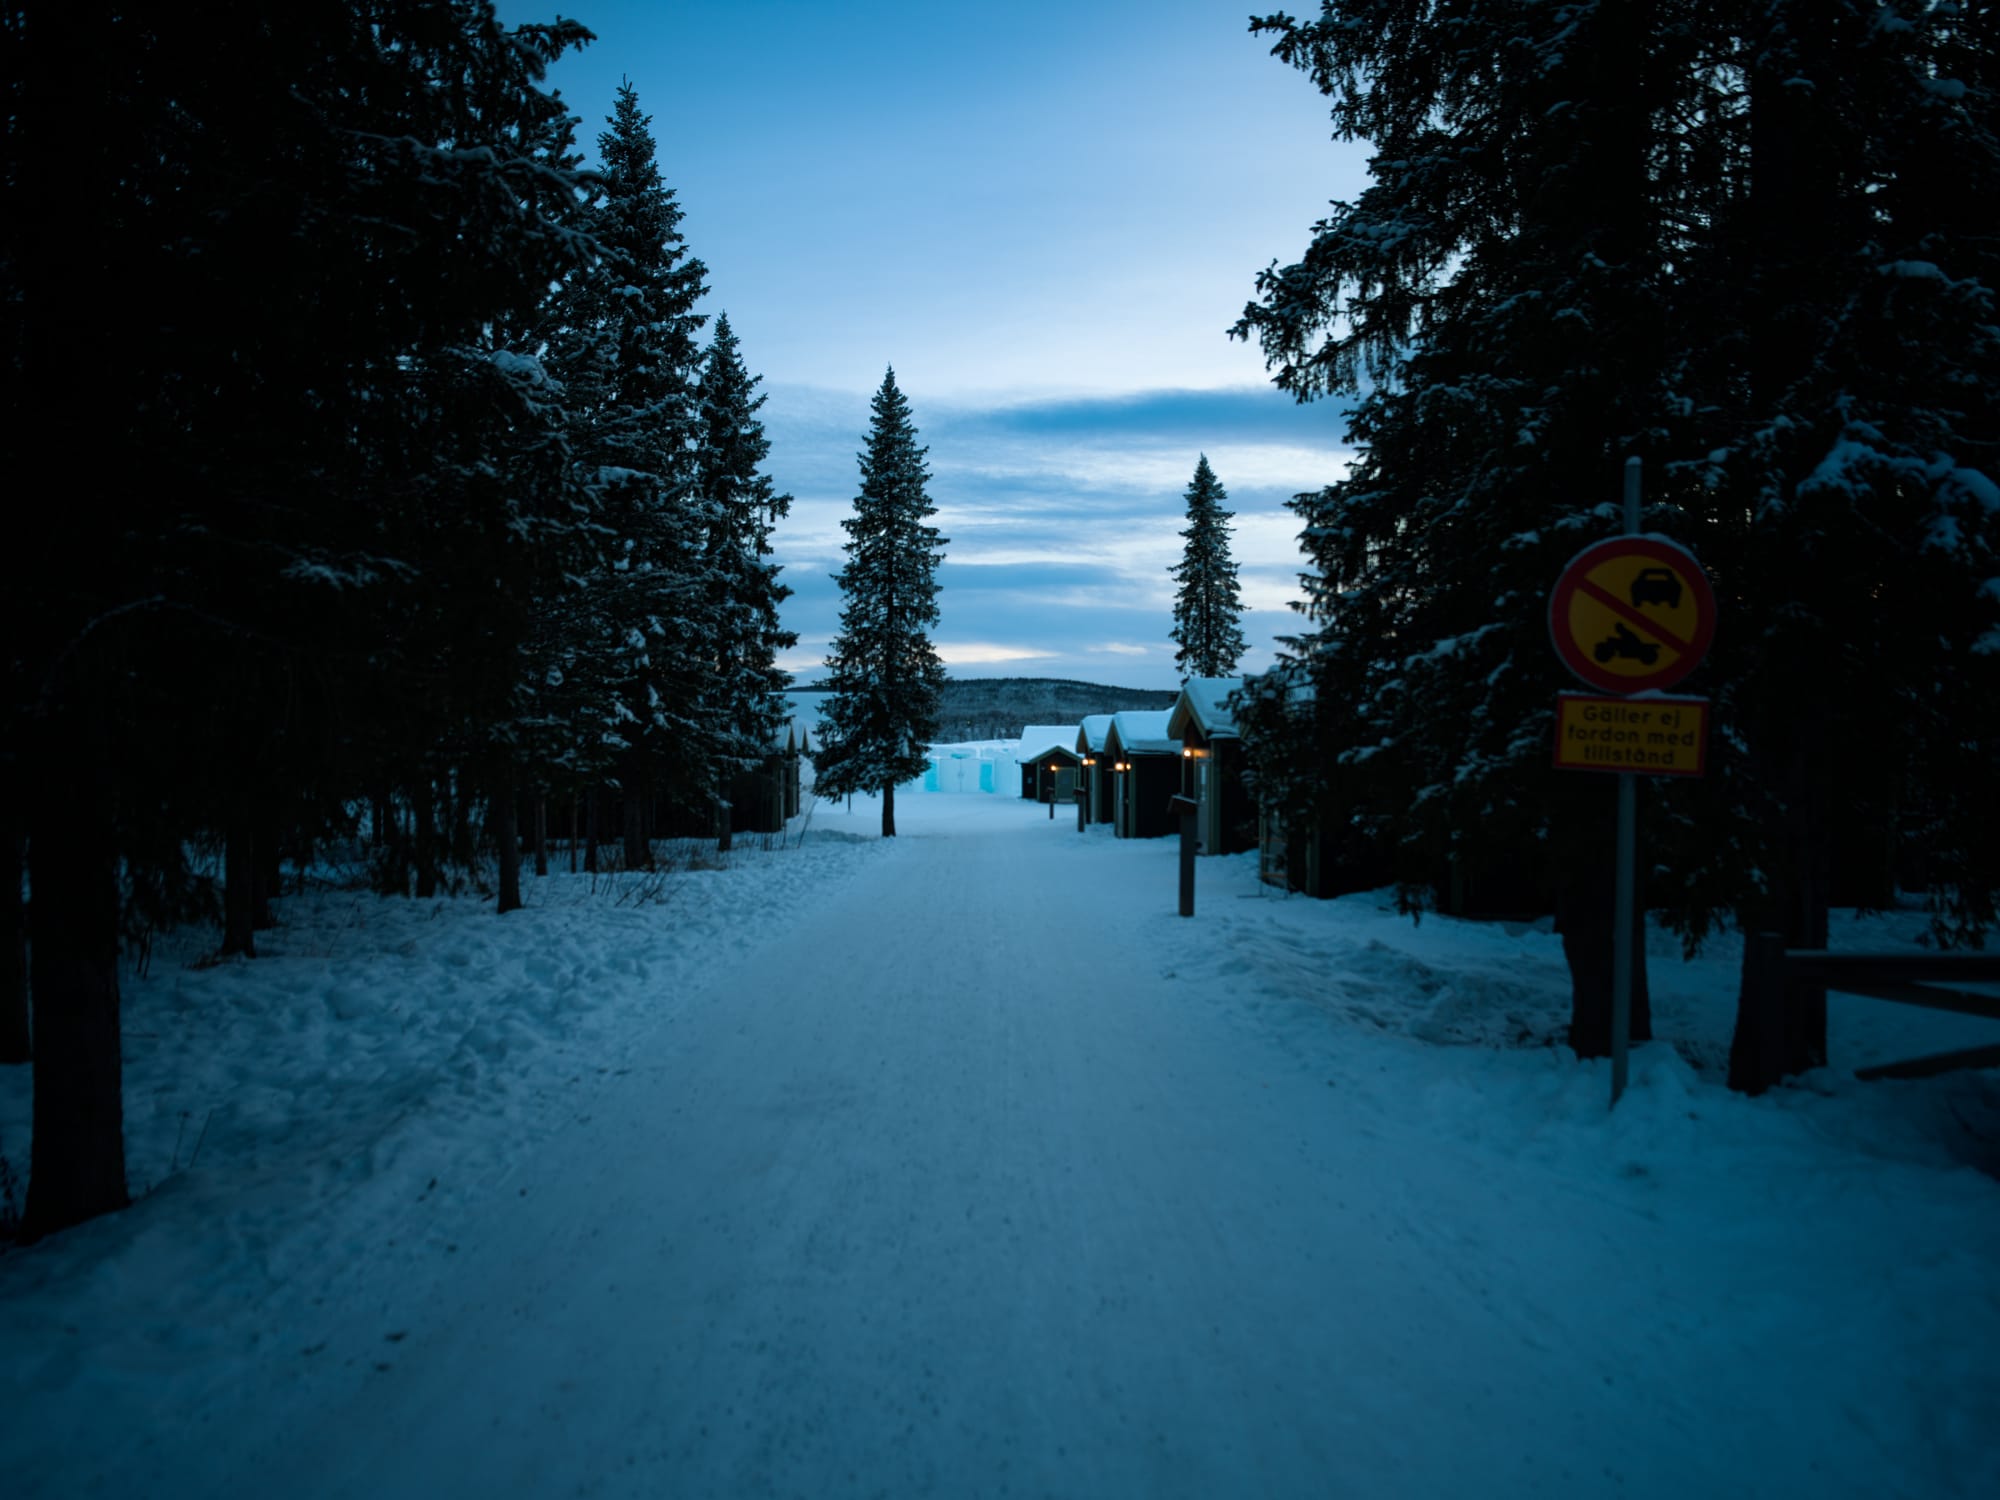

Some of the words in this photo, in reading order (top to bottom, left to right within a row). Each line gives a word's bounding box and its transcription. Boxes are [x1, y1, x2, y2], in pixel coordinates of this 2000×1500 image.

[1583, 705, 1651, 724] Gäller
[1661, 709, 1681, 729] ej
[1568, 725, 1640, 744] fordon
[1647, 731, 1695, 747] med
[1584, 745, 1674, 765] tillstånd
